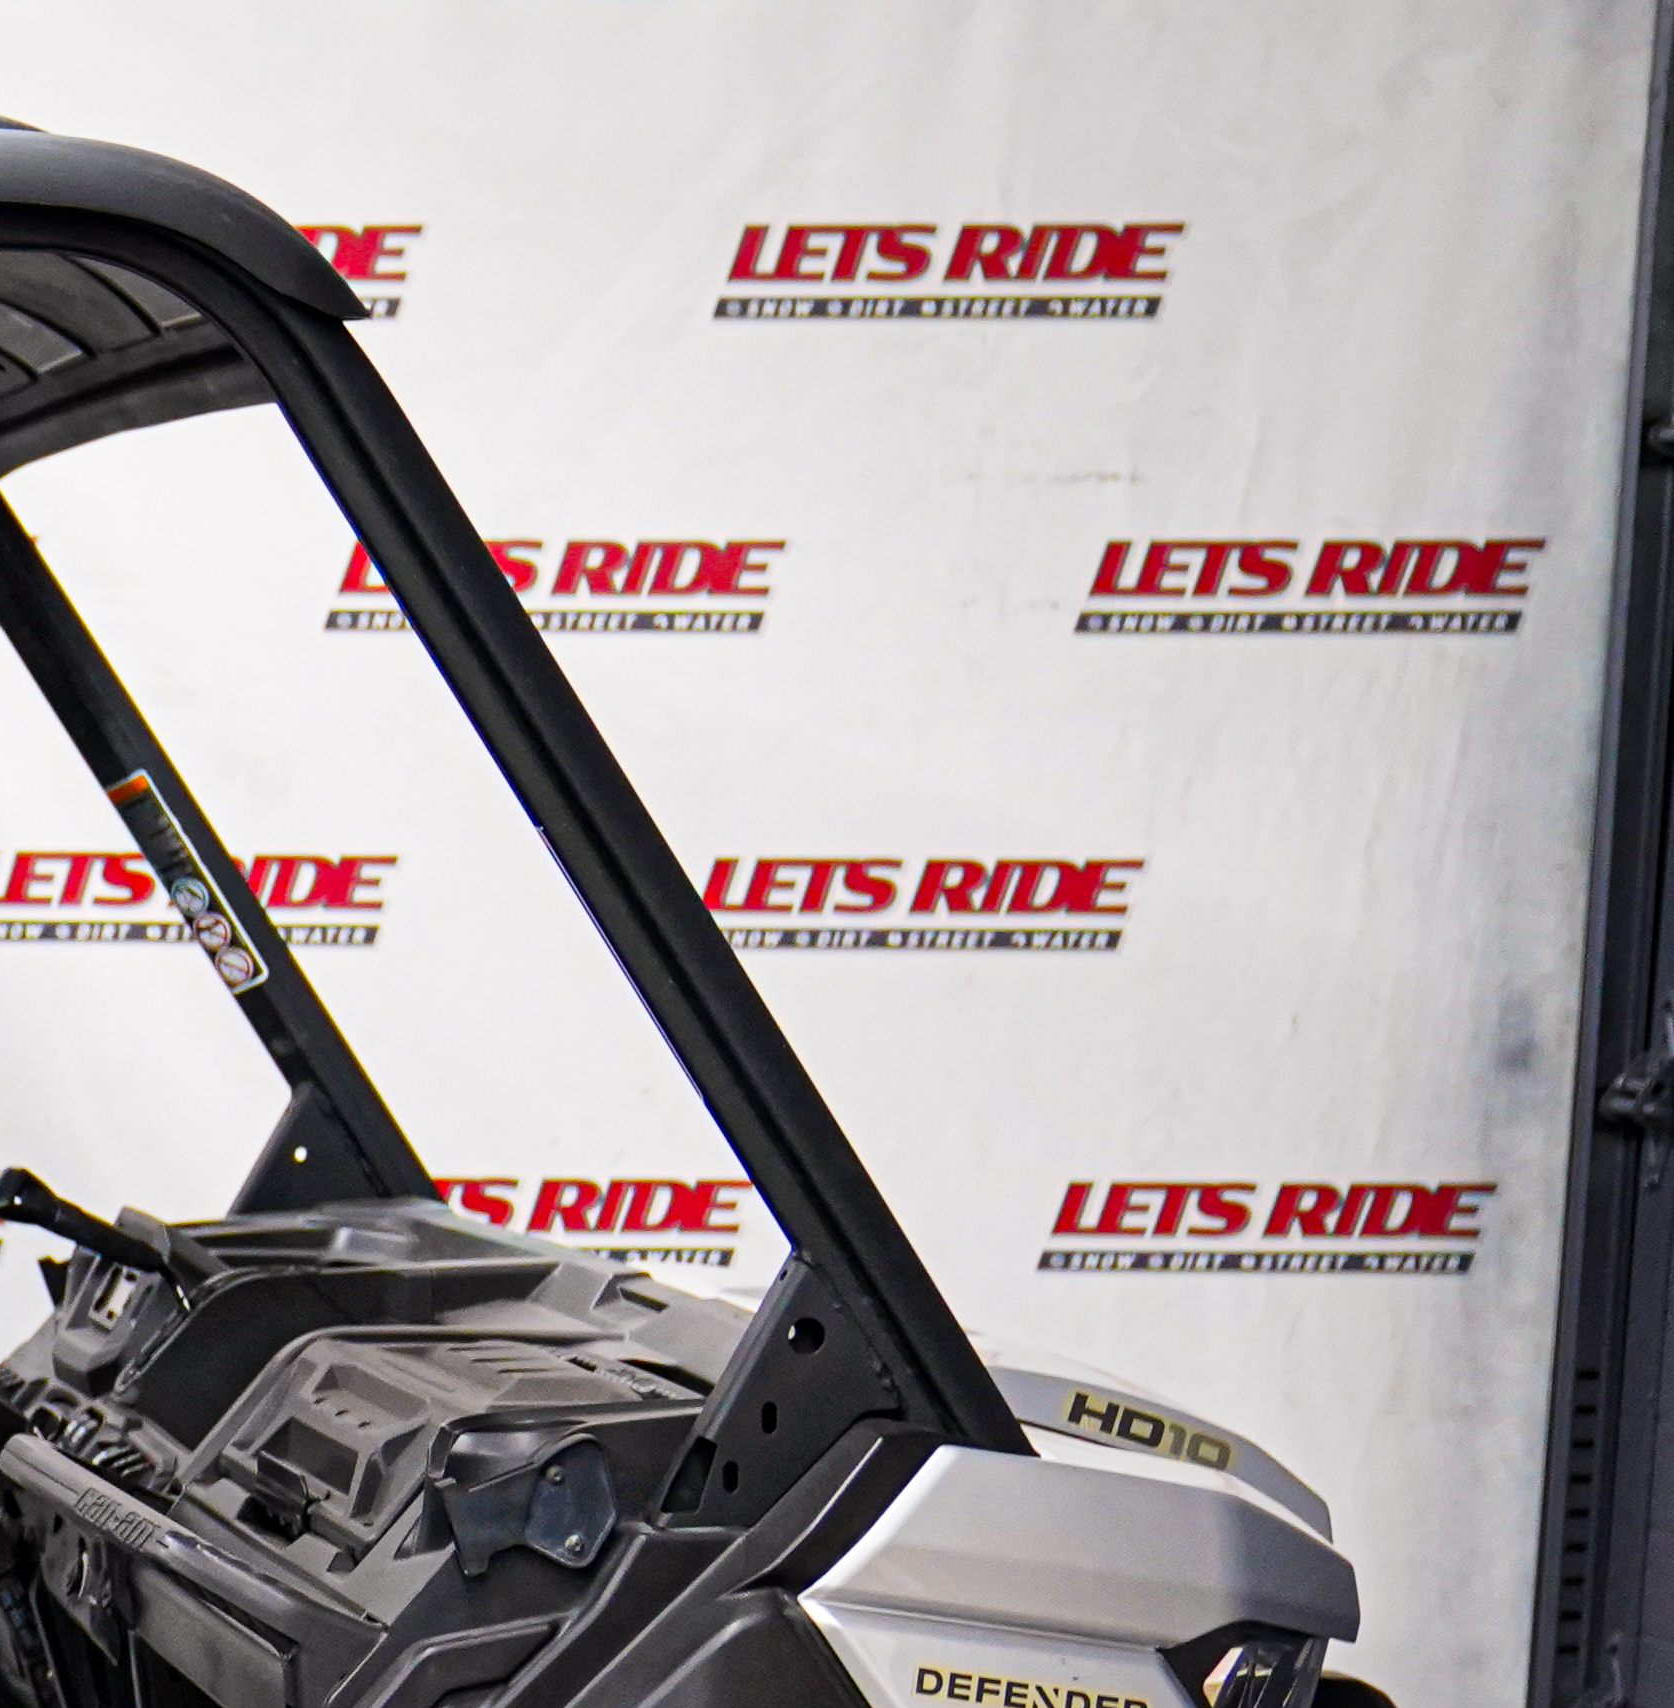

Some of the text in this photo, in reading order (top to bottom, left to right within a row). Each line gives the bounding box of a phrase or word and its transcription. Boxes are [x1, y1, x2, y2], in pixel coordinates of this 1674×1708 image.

[727, 223, 1185, 284] LETS RIDE
[338, 539, 786, 598] LS RIDE
[1089, 539, 1548, 599] LETS RIDE
[229, 855, 398, 910] IDE
[697, 857, 1148, 917] LETS RIDE
[524, 1177, 761, 1236] RIDE
[1050, 1181, 1499, 1240] LETS RIDE
[1065, 1391, 1232, 1471] HD10
